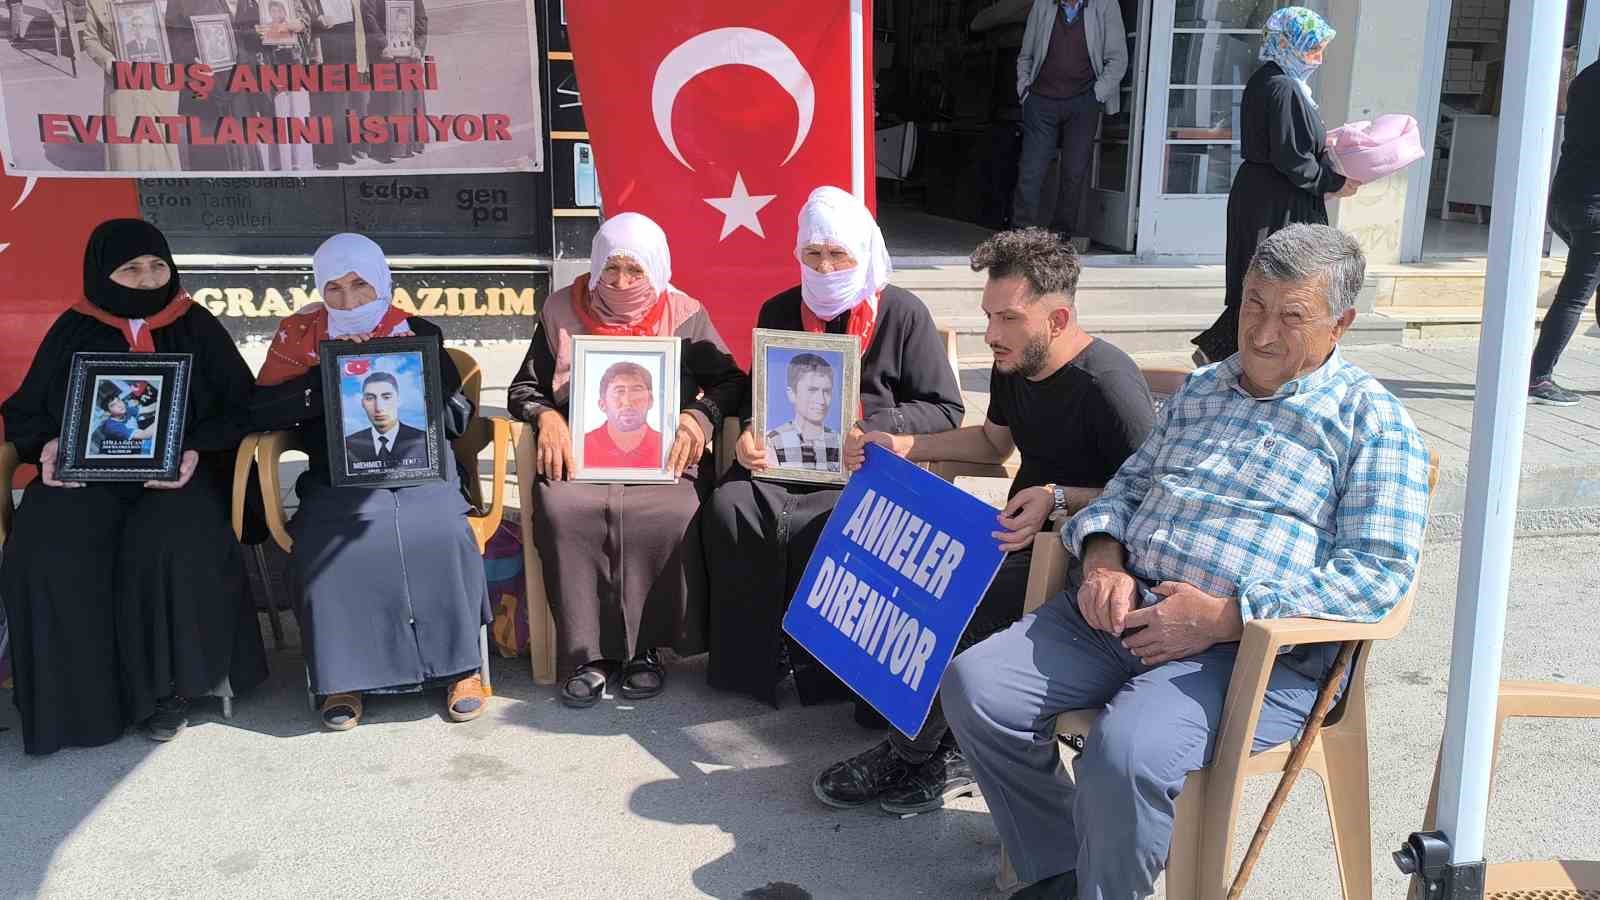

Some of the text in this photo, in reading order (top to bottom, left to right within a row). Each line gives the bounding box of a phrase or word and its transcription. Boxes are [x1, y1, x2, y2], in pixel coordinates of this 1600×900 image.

[112, 55, 439, 101] MUŞ ANNELERİ
[38, 105, 513, 145] EVLATLARINI İSTİYOR
[456, 187, 508, 210] gen
[472, 205, 509, 227] pa
[841, 488, 966, 600] ANNELER
[806, 552, 937, 692] DİRENİYOR
